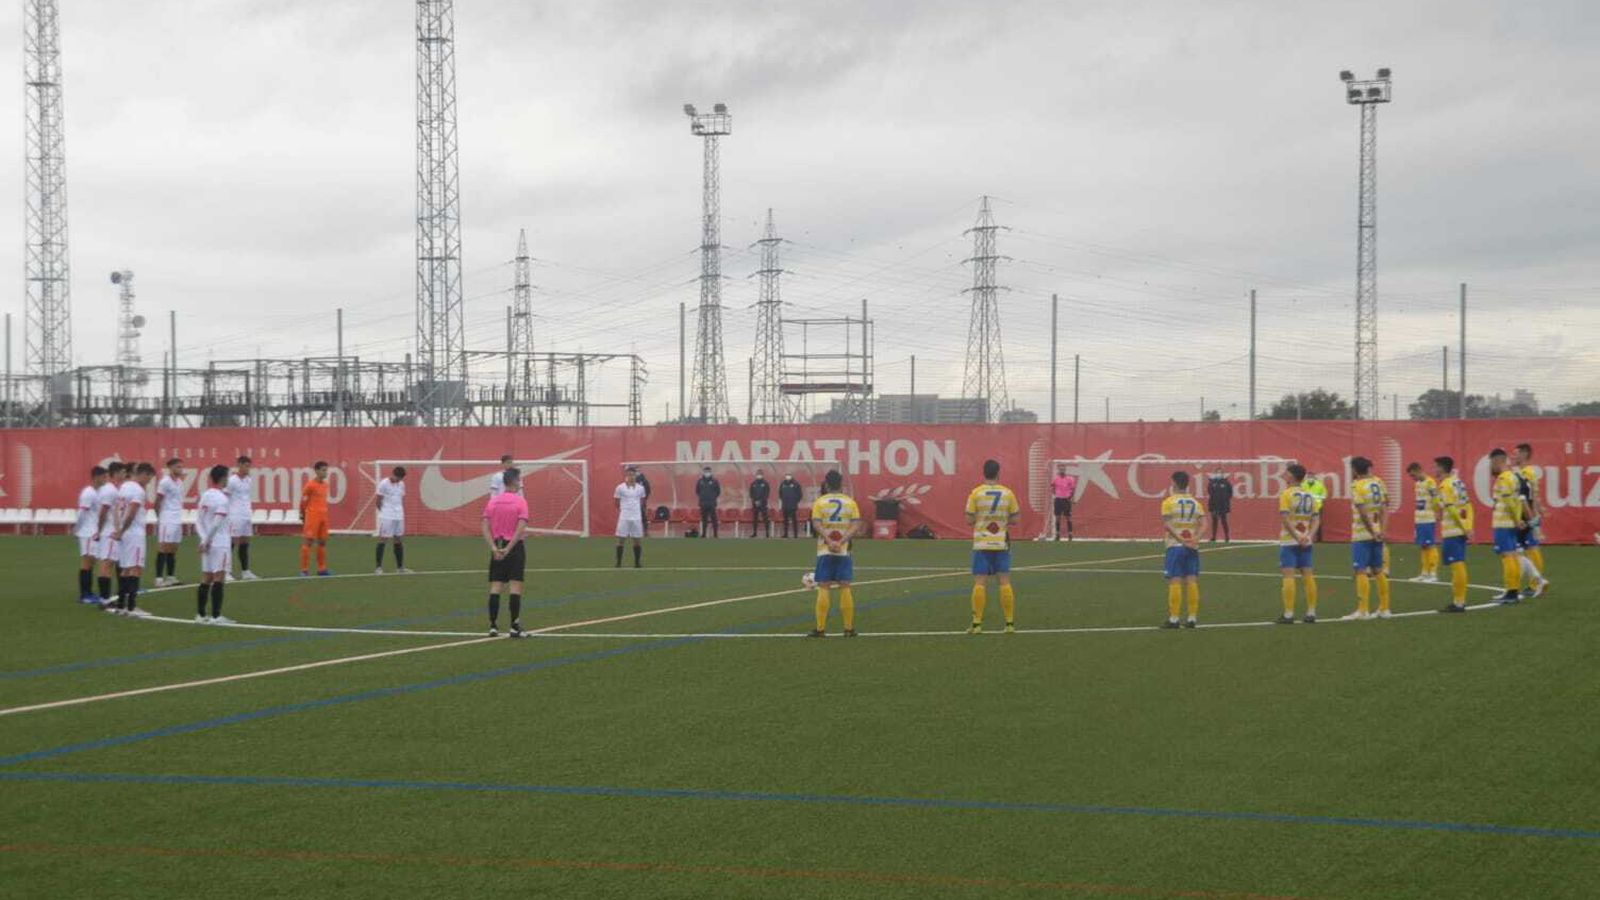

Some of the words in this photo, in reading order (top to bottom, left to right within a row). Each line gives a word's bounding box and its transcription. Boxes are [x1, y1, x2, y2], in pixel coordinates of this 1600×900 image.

[675, 439, 956, 475] MARATHON
[985, 491, 1003, 514] 7
[1294, 492, 1313, 514] 20
[1370, 483, 1381, 504] 8
[828, 499, 842, 522] 2
[1177, 499, 1196, 521] 17
